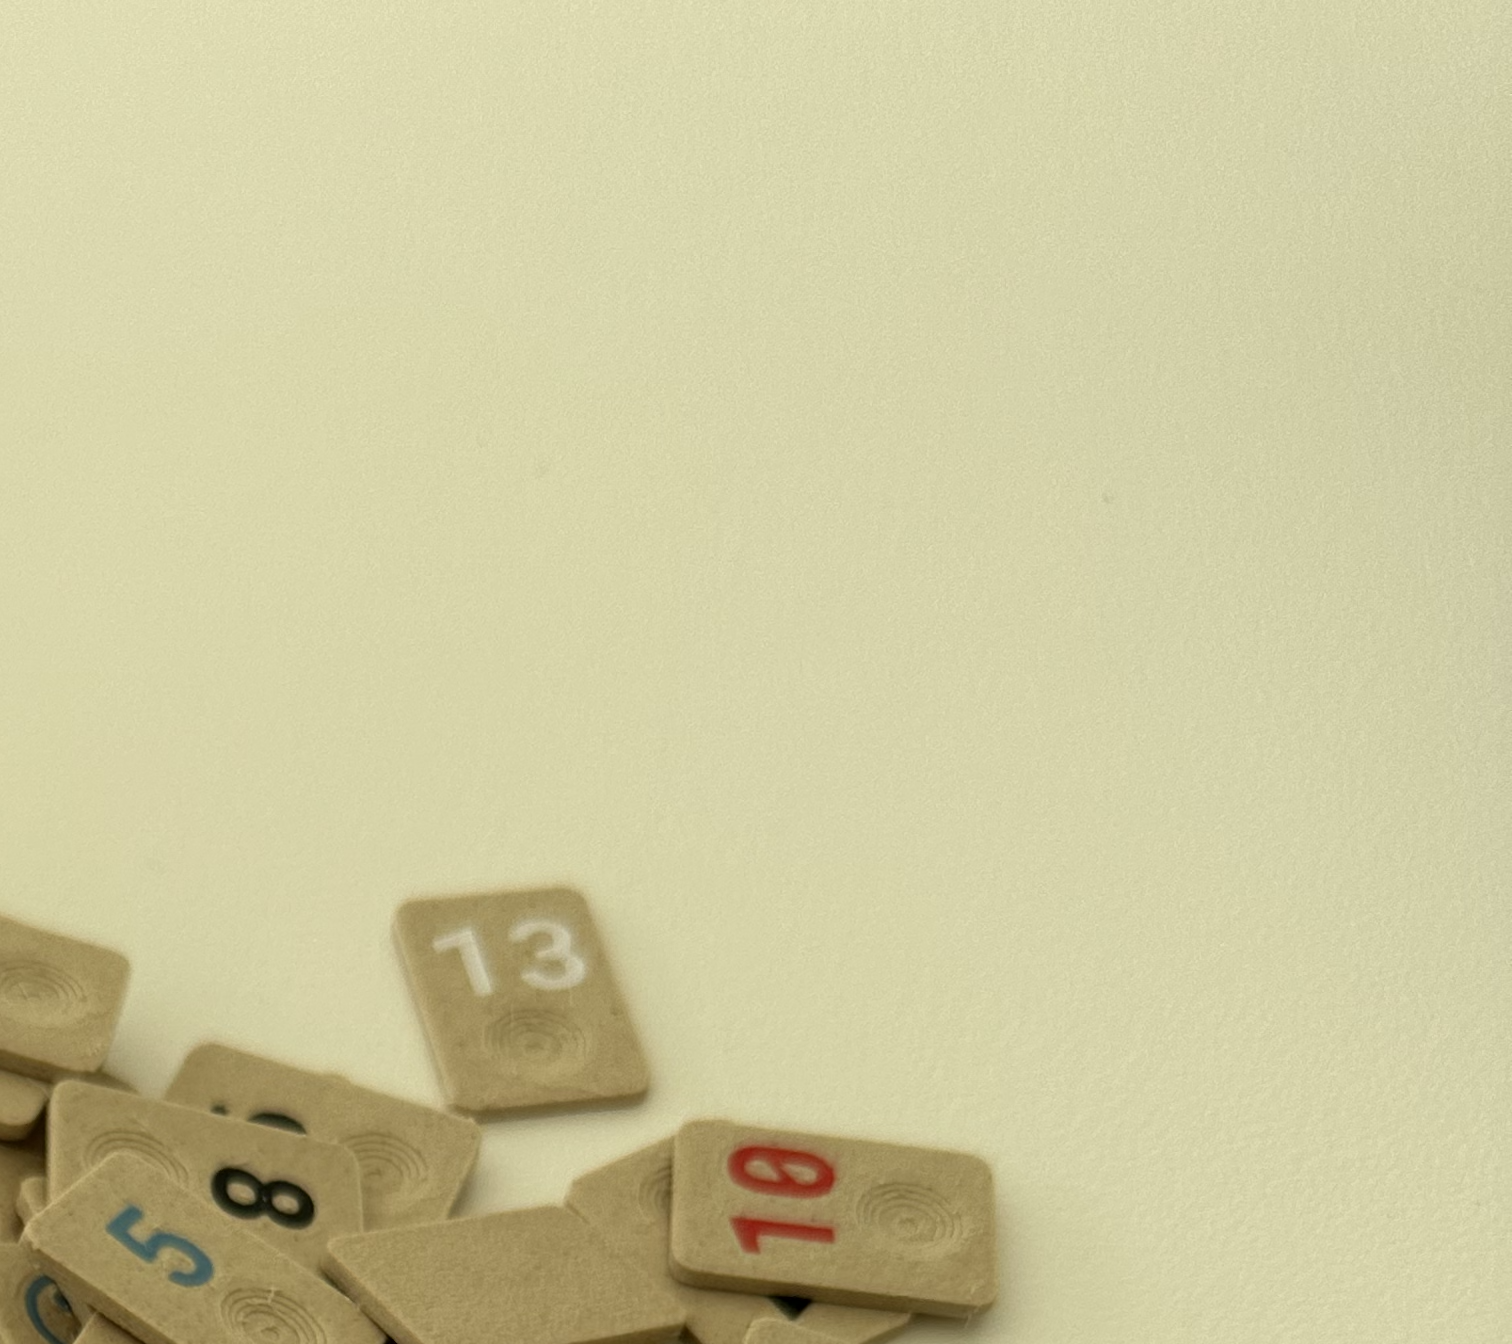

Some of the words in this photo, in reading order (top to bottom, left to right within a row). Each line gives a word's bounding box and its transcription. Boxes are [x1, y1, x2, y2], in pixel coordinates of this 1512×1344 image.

[431, 920, 586, 999] 13
[210, 1167, 316, 1231] 8
[726, 1143, 837, 1256] 10
[104, 1204, 215, 1287] 5
